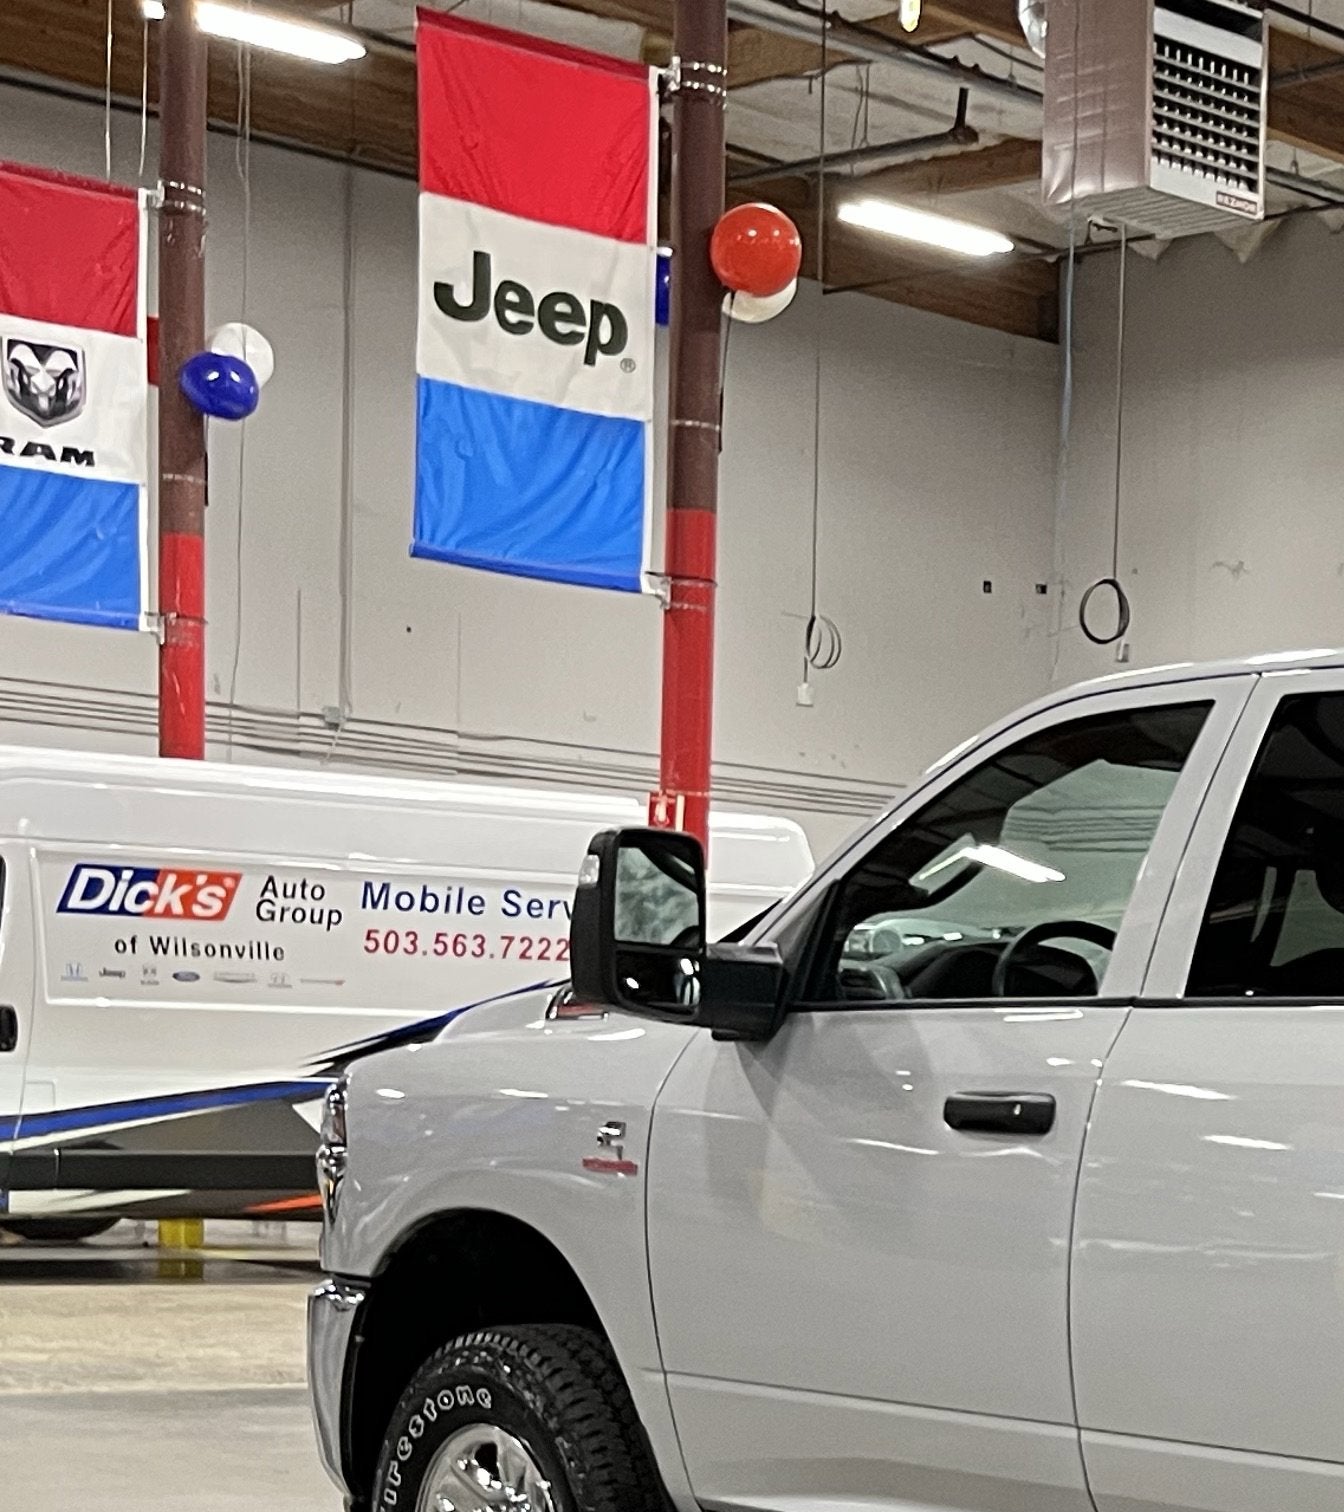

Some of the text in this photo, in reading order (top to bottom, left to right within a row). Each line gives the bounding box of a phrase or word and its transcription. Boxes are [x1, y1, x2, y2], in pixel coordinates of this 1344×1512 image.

[433, 250, 629, 368] Jeep
[260, 875, 326, 901] Auto
[361, 880, 486, 916] Mobile
[255, 898, 343, 932] Group
[114, 935, 285, 962] of Wilsonville
[363, 928, 571, 962] 503.563.7222
